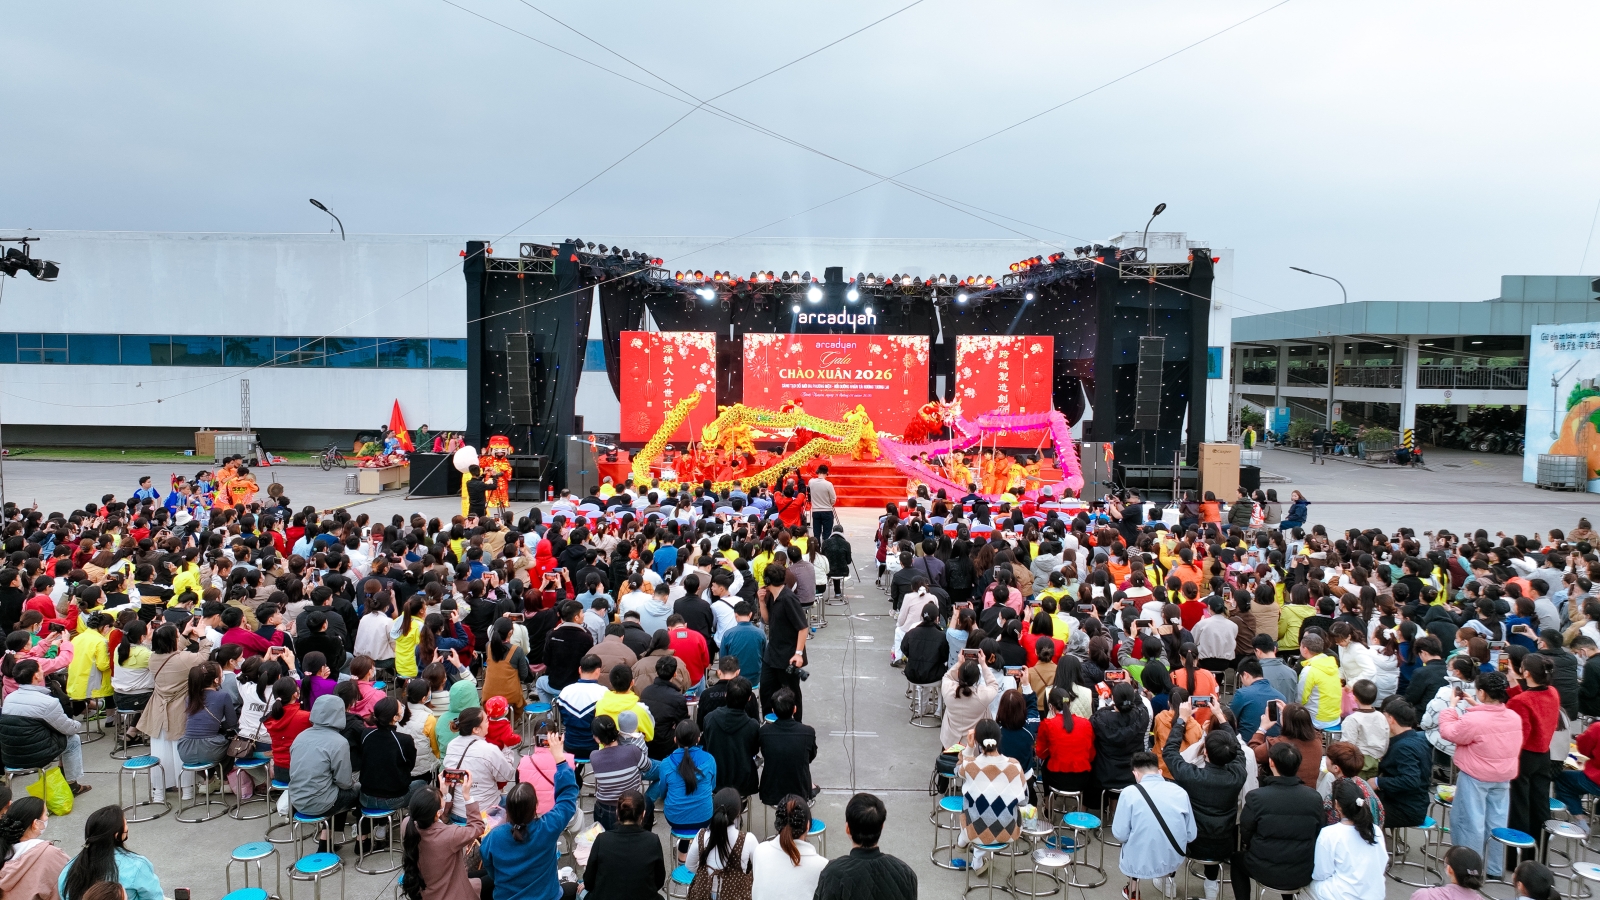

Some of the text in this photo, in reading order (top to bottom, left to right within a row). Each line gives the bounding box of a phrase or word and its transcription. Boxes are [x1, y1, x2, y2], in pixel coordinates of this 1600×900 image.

[798, 306, 877, 333] arcadyan
[815, 338, 857, 354] arcadyan
[819, 351, 853, 368] Gala
[779, 367, 893, 380] CHÀO XUÂN 2026
